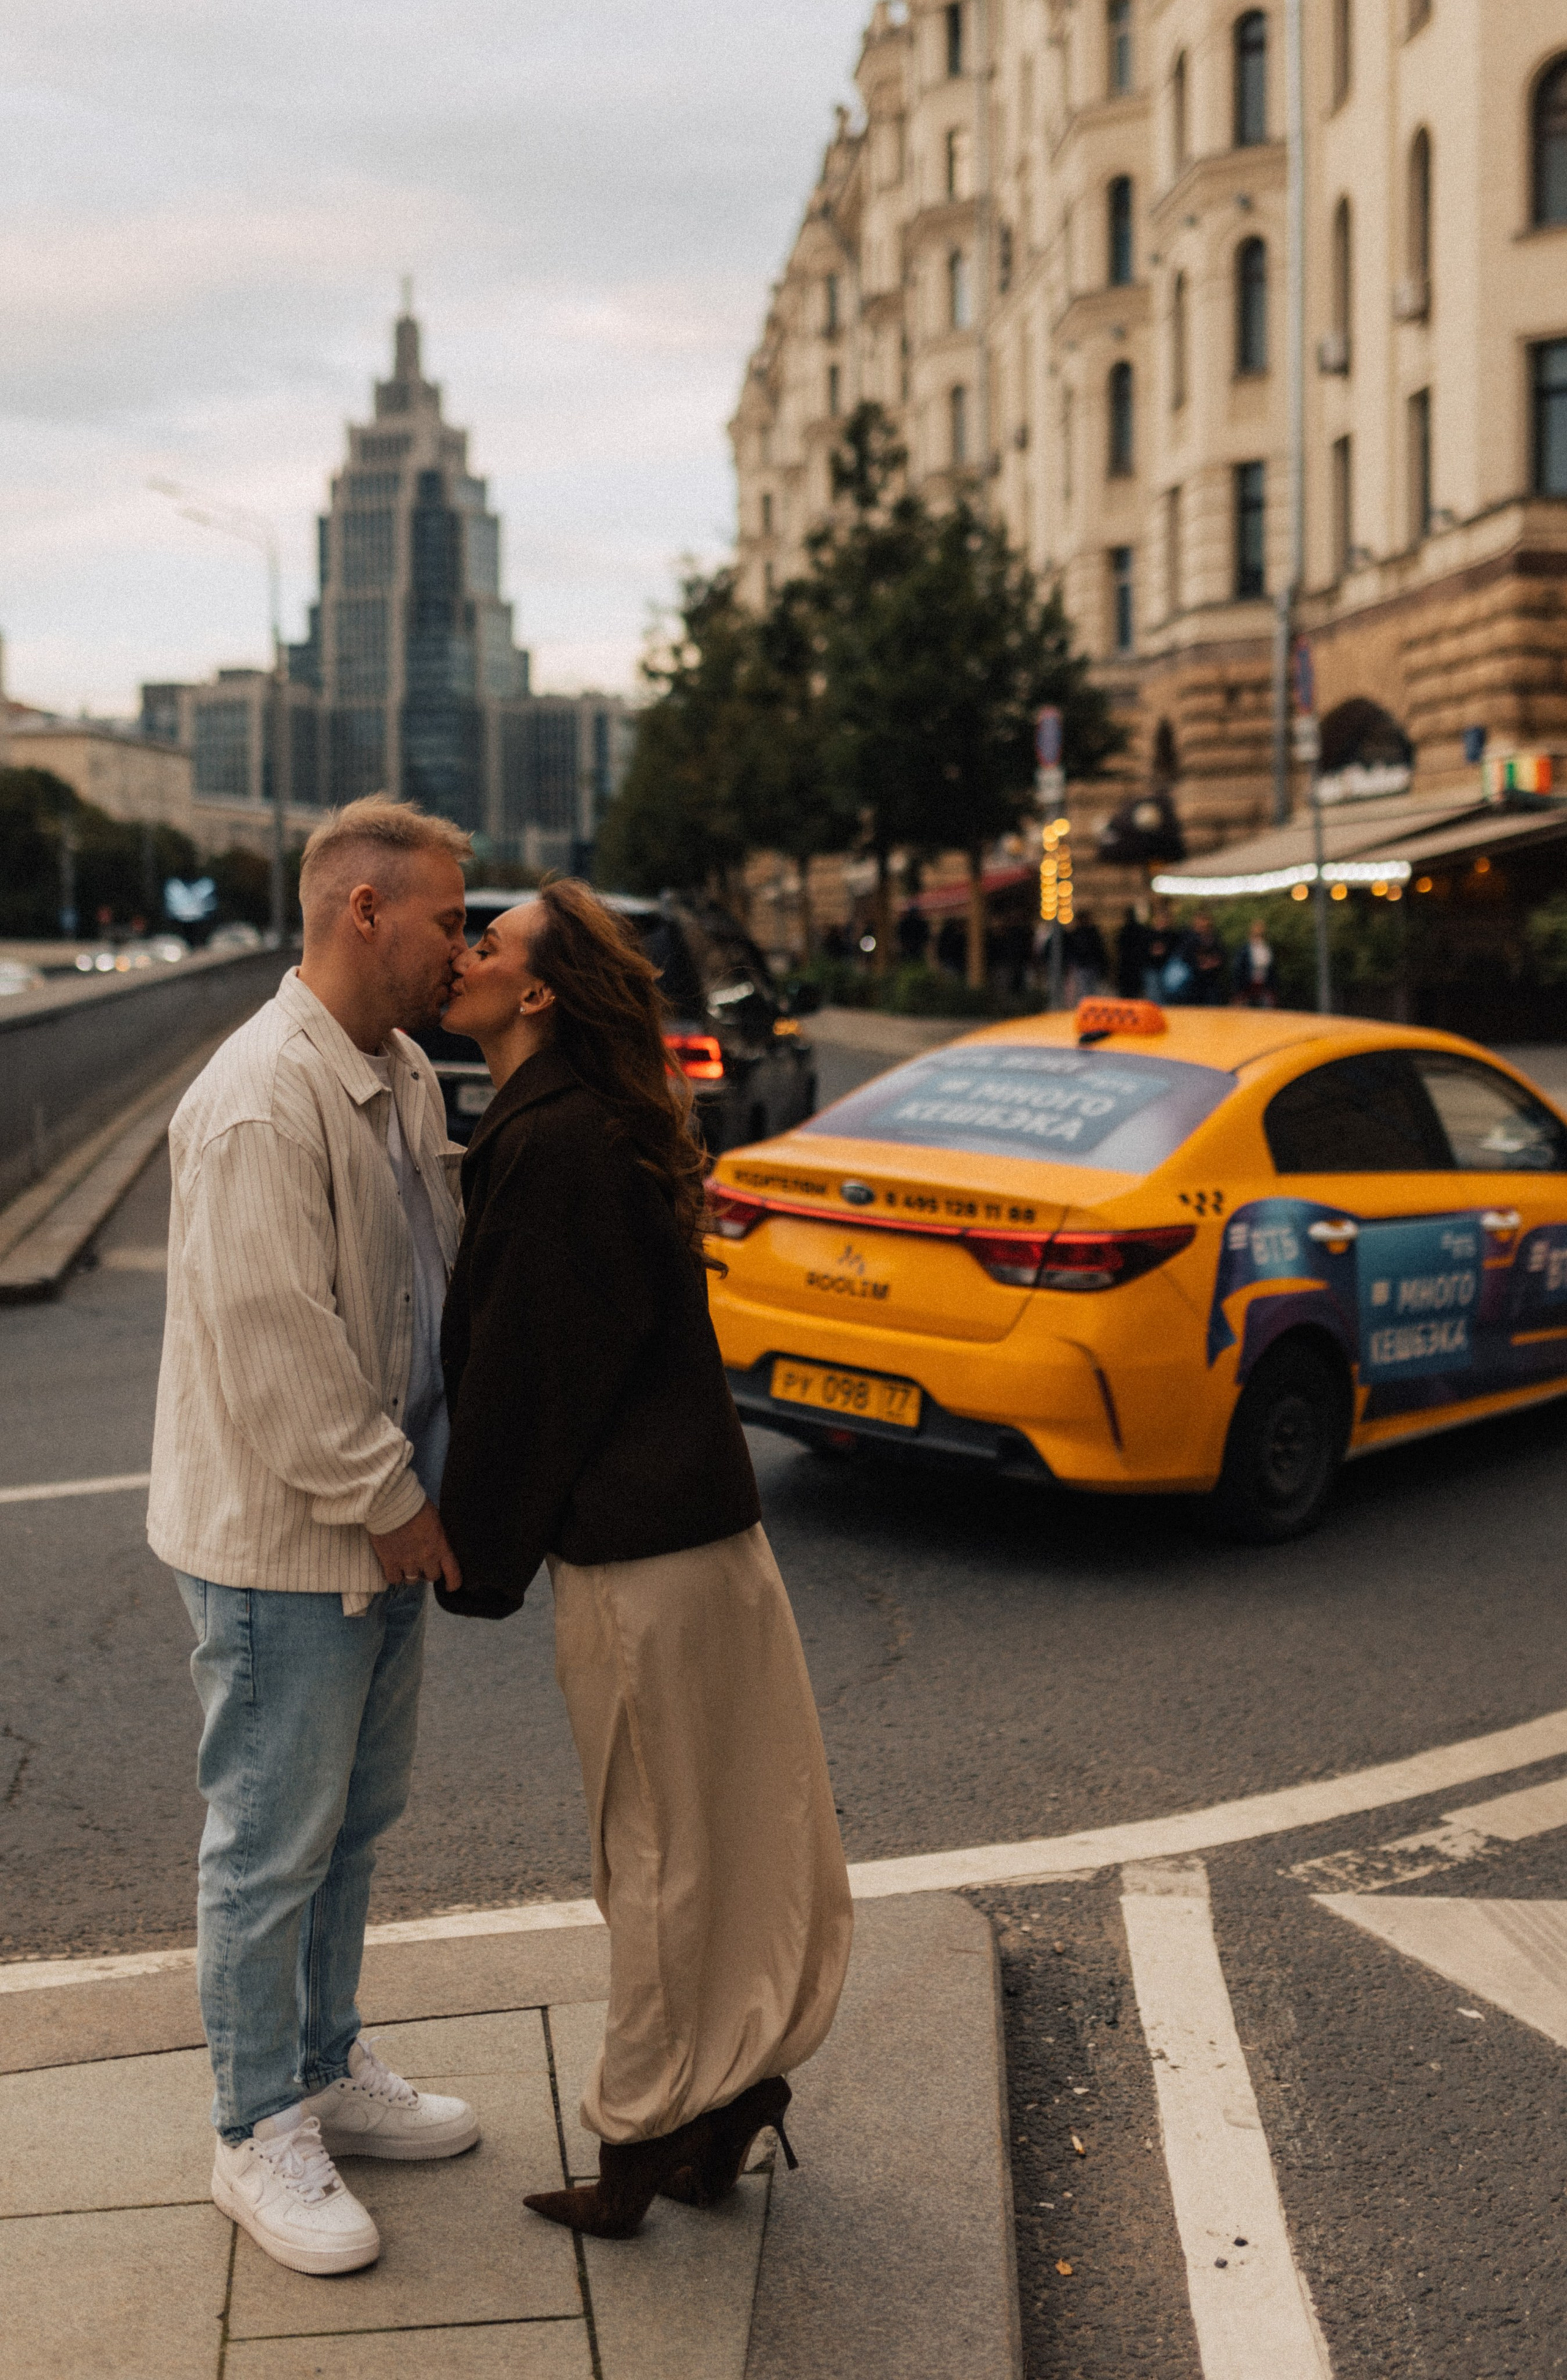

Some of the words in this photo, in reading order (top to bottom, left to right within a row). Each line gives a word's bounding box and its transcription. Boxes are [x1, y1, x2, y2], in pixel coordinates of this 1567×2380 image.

[968, 1081, 1116, 1117] МНОГО
[885, 1191, 896, 1207] 8
[903, 1195, 938, 1214] 495
[945, 1199, 978, 1218] 128
[984, 1203, 1002, 1221] 11
[1398, 1270, 1475, 1313] МНОГО
[822, 1375, 869, 1410] 098
[884, 1386, 911, 1412] 77
